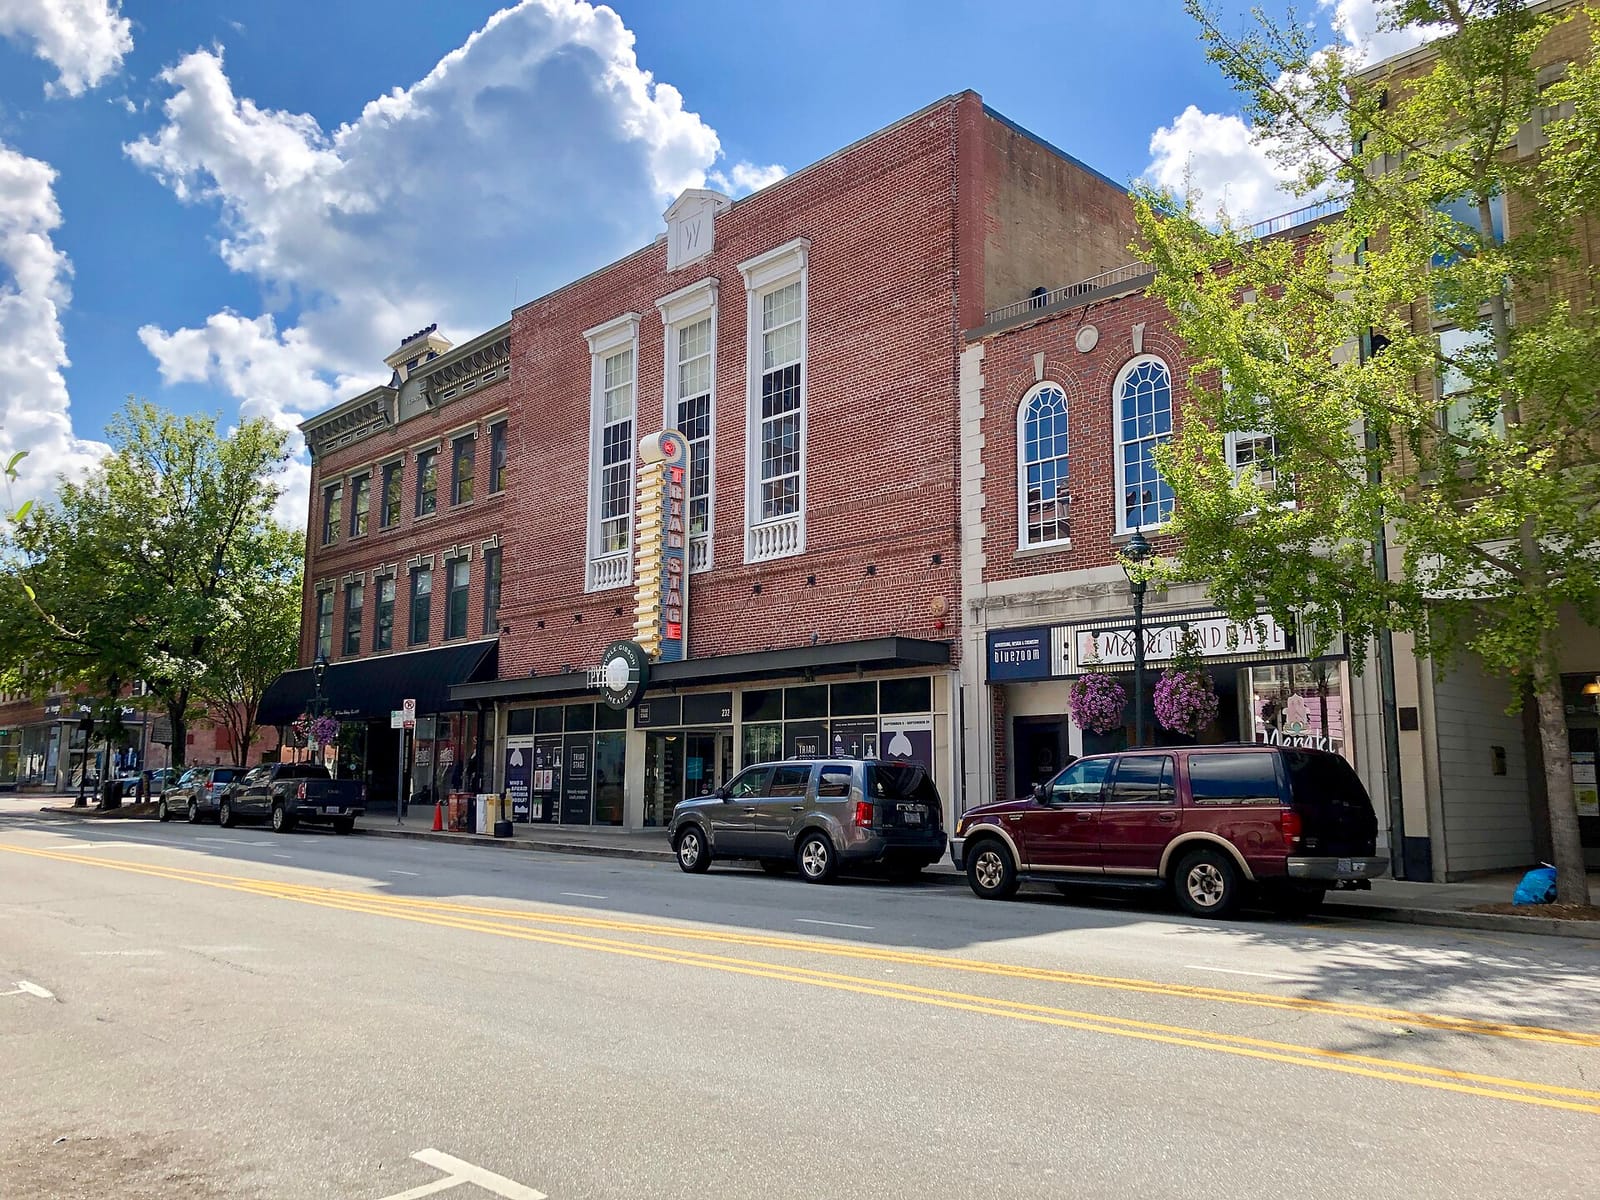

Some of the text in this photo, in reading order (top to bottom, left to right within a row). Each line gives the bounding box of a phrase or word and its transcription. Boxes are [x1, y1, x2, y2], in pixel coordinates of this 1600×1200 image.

[685, 219, 701, 250] W
[666, 466, 685, 640] TRIAD STAGE
[1105, 630, 1163, 657] Merki
[618, 644, 636, 666] GIBSON
[994, 649, 1040, 666] bluezoom
[605, 689, 633, 704] THEATER
[799, 744, 816, 755] TRIAD
